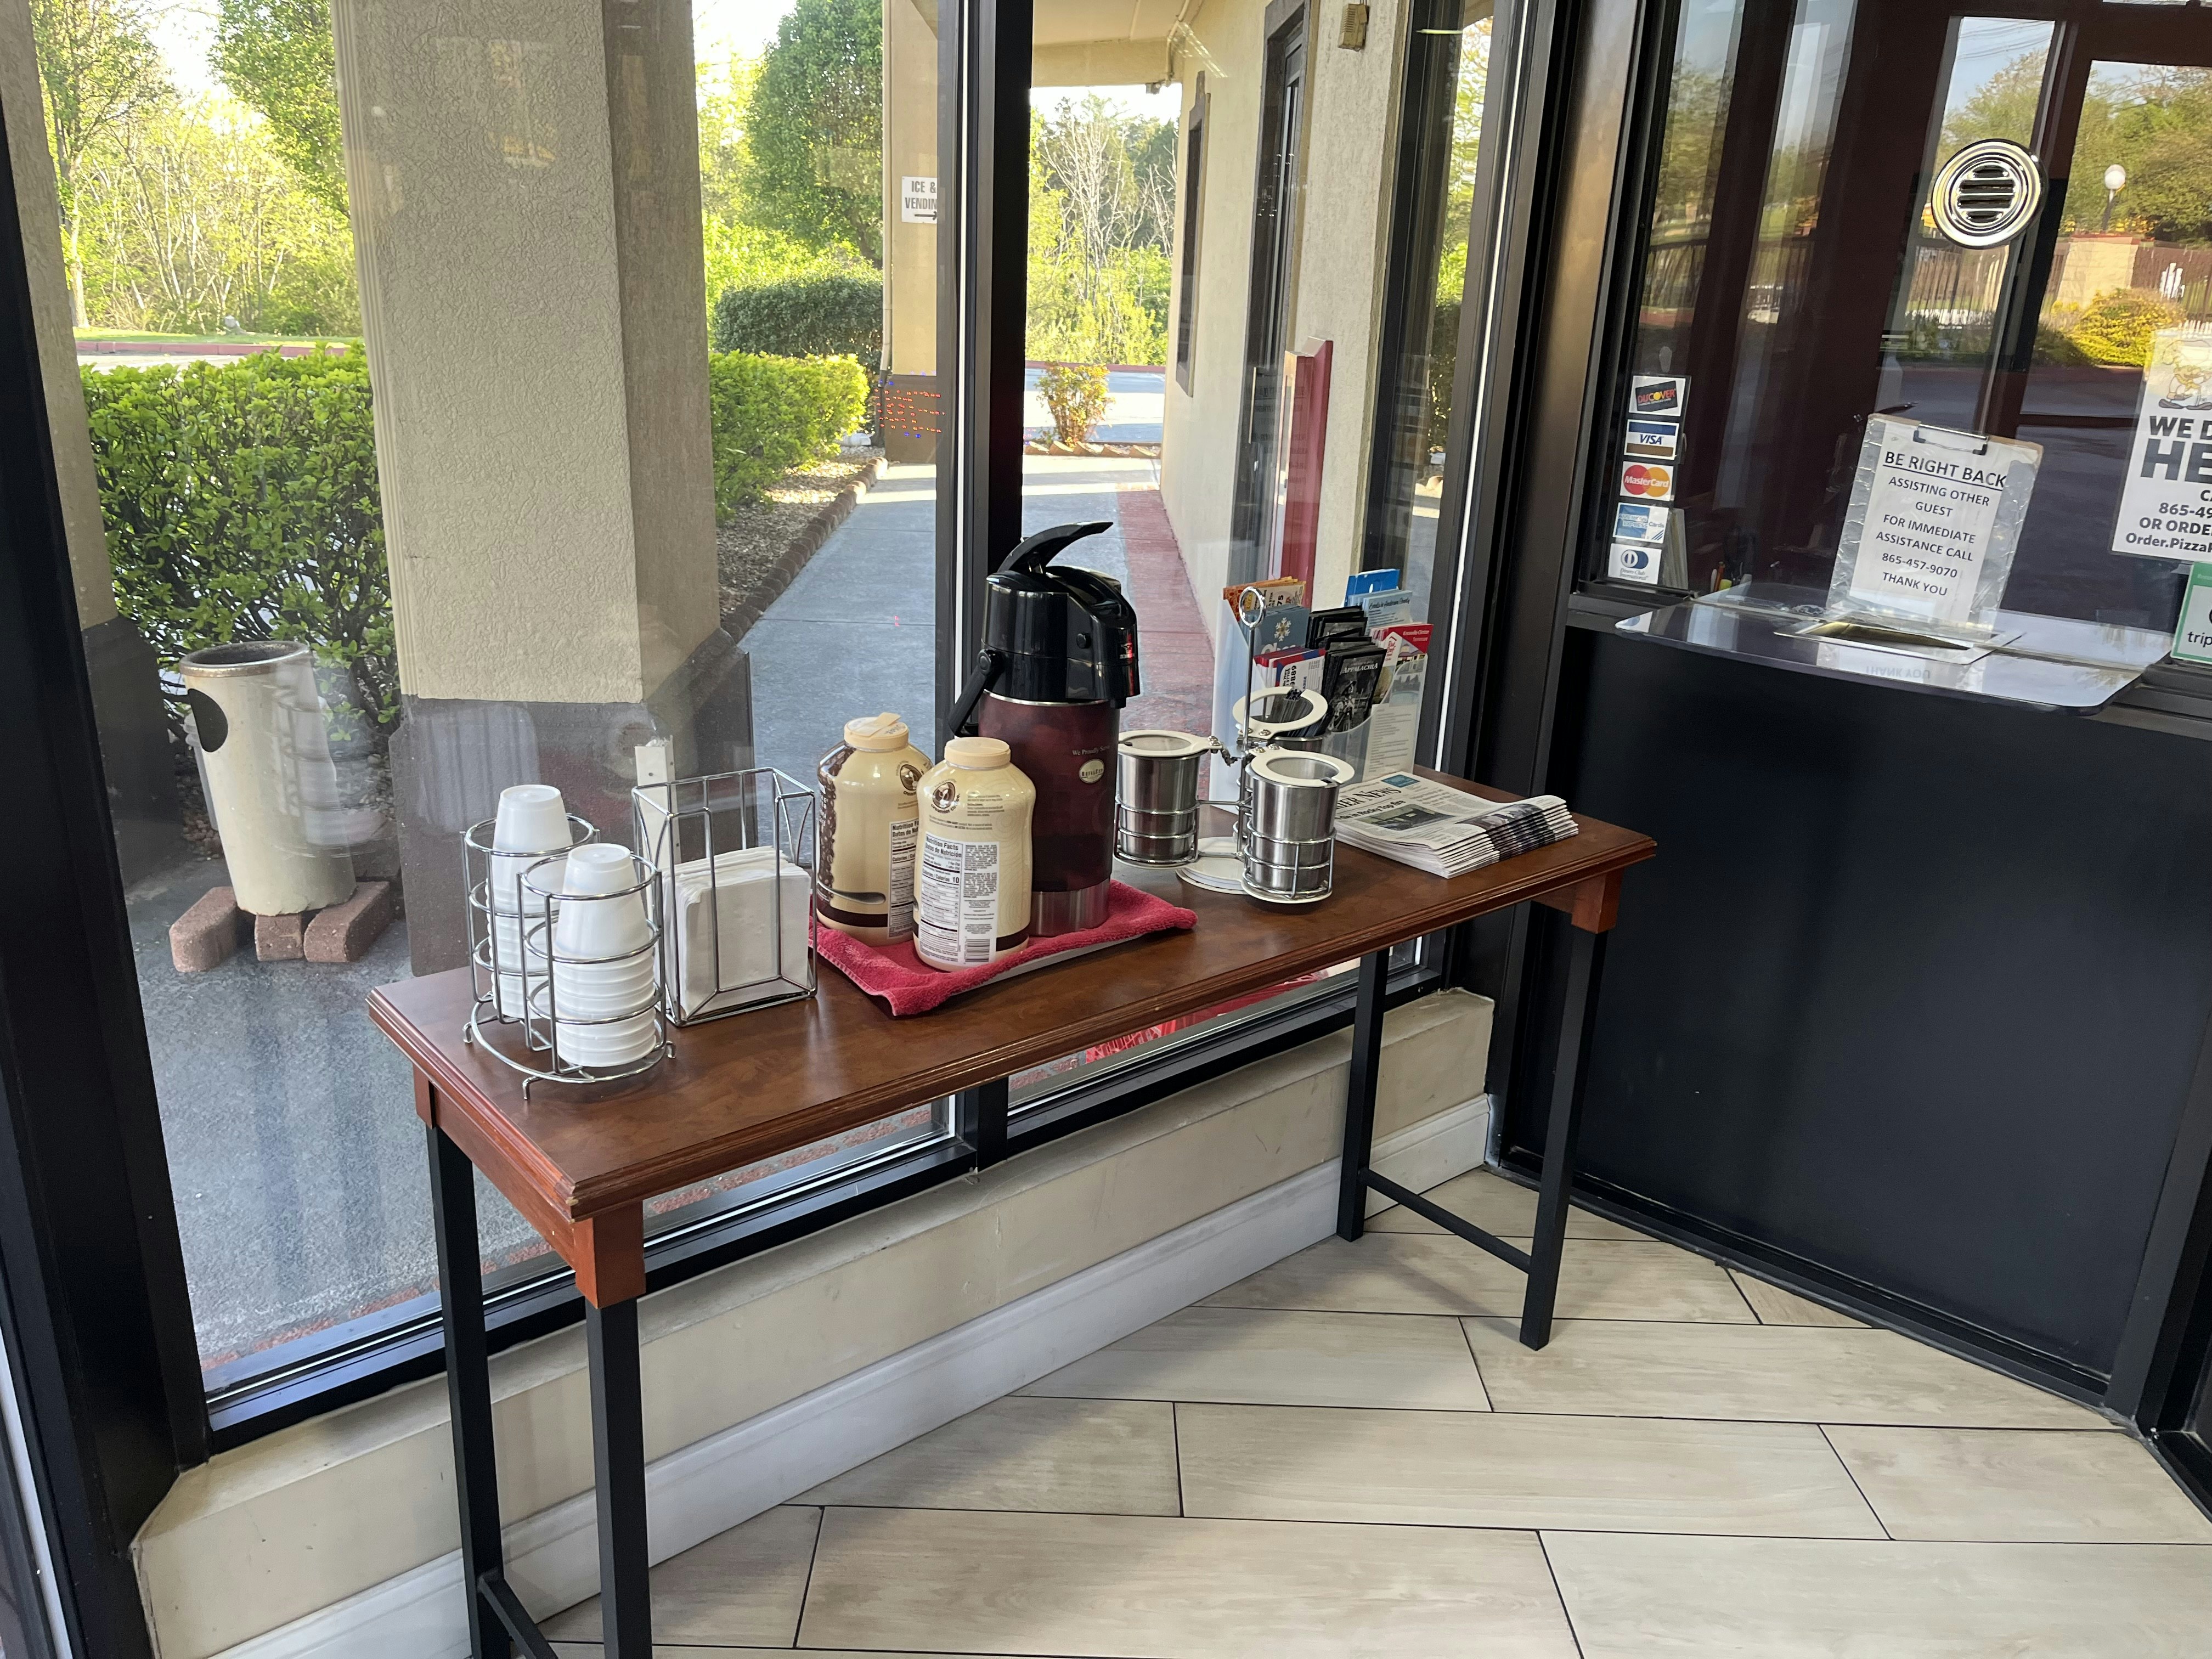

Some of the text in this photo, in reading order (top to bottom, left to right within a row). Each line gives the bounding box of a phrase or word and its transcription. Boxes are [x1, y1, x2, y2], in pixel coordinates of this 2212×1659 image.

[911, 180, 936, 193] ICE &
[905, 198, 938, 210] VENDIN
[2149, 415, 2195, 438] WE
[1639, 434, 1663, 445] VISA
[1885, 451, 2007, 488] BE RIGHT BACK
[2141, 438, 2212, 484] HE
[1624, 475, 1669, 489] MasterCard
[1888, 476, 1990, 506] ASSISTING OTHER
[1915, 501, 1953, 517] GUEST
[2159, 503, 2212, 518] 865-49
[1883, 515, 1977, 544] FOR IMMEDIATE
[2140, 517, 2212, 537] OR ORDE
[1876, 531, 1973, 562] ASSISTANCE CALL
[1882, 552, 1958, 578] 865-457-9070
[1882, 572, 1948, 596] THANK YOU
[2188, 631, 2212, 648] trip
[1352, 787, 1402, 802] NEWS
[944, 843, 958, 851] Facts
